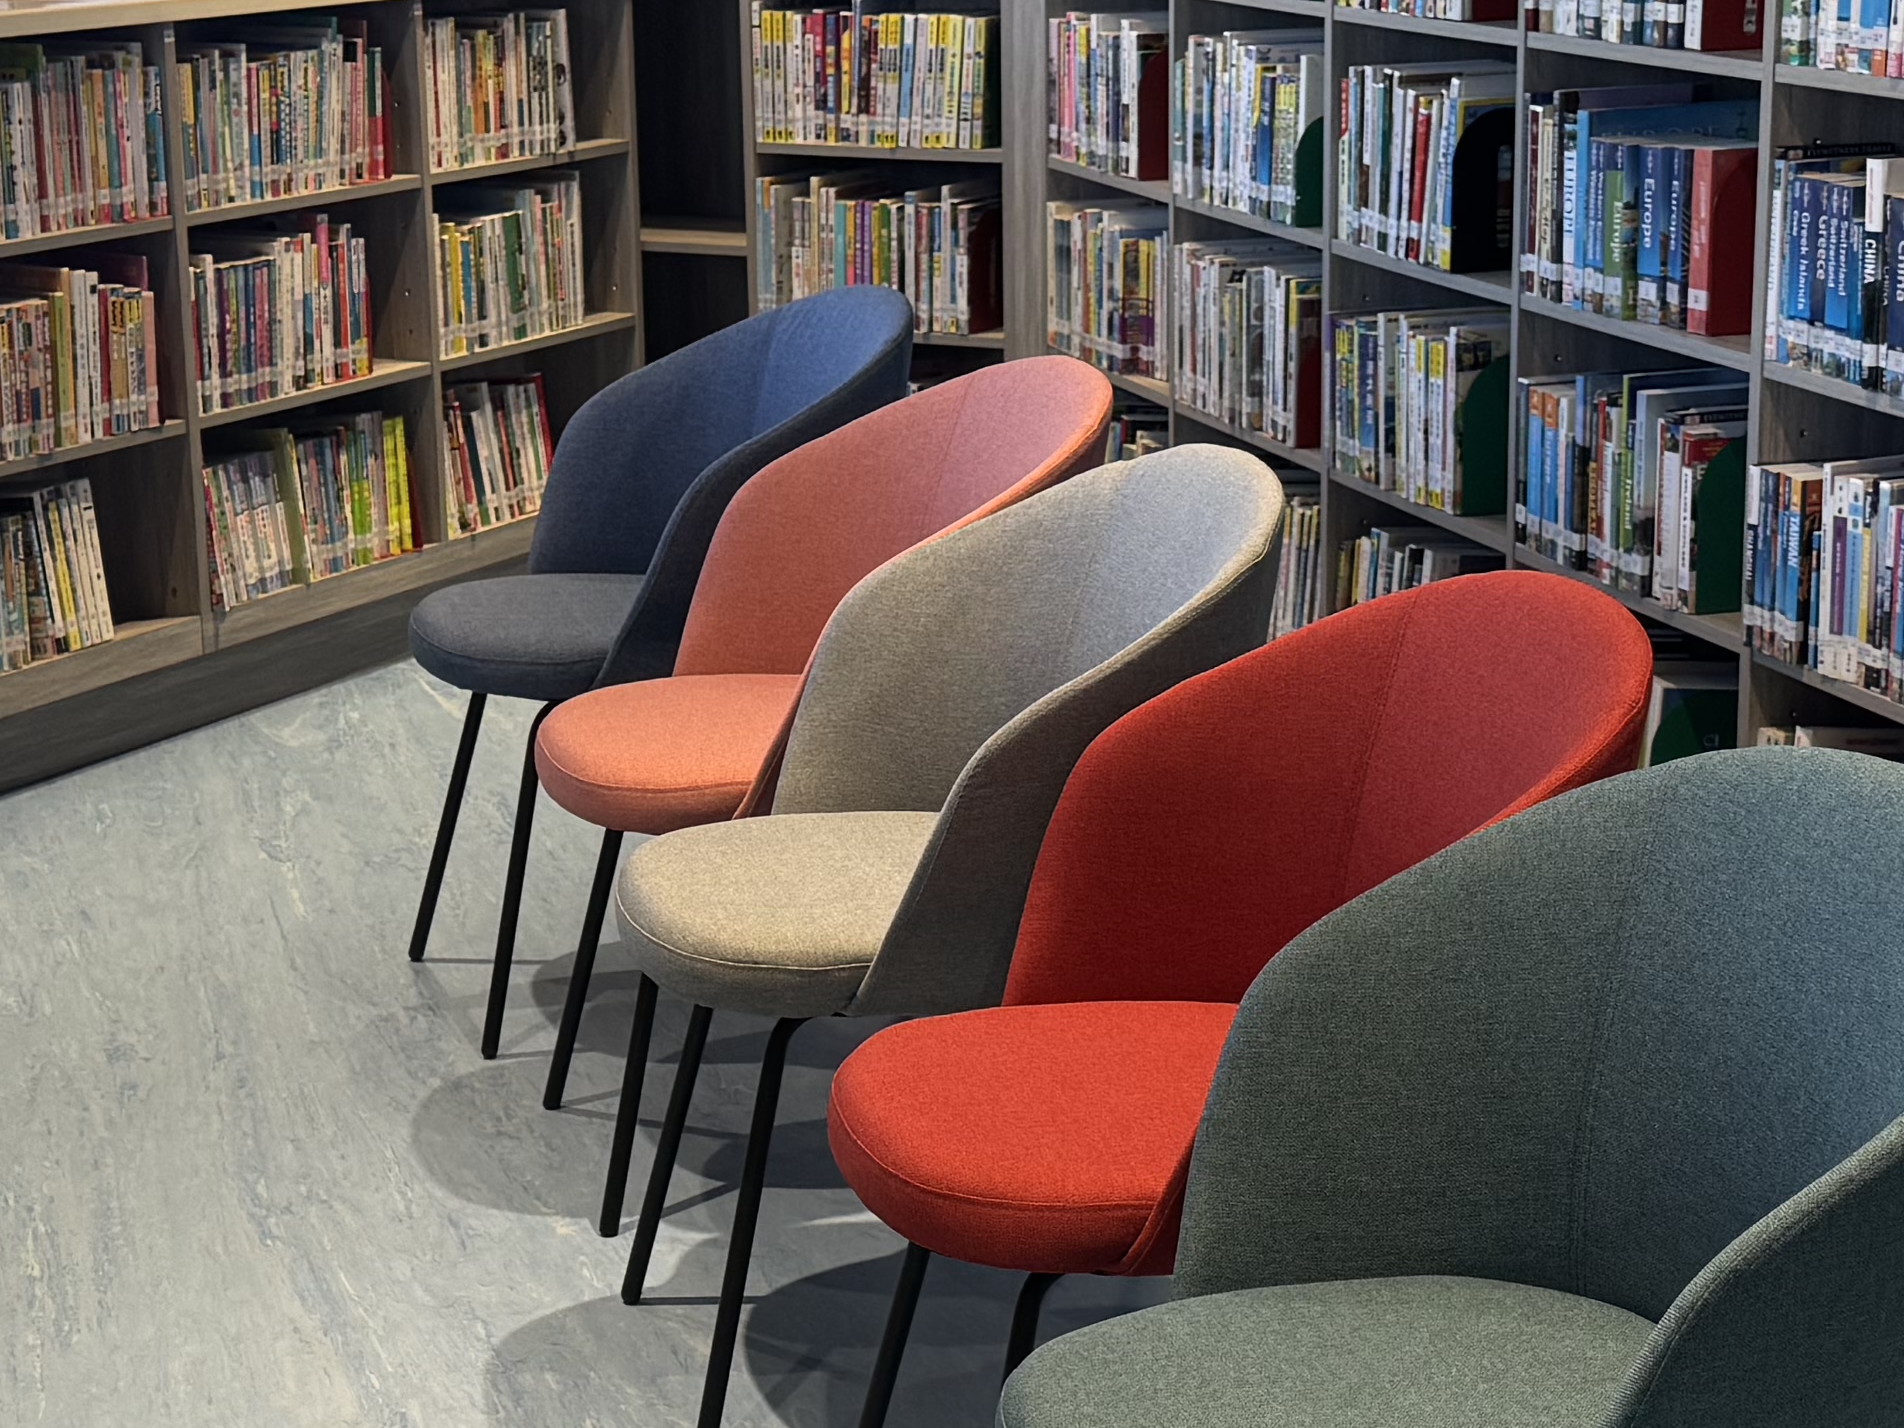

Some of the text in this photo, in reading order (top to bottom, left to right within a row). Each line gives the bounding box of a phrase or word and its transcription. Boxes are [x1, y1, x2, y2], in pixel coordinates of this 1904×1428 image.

[1643, 176, 1657, 249] Europe
[1863, 239, 1877, 285] CHINA
[1787, 515, 1801, 568] TAIWAN
